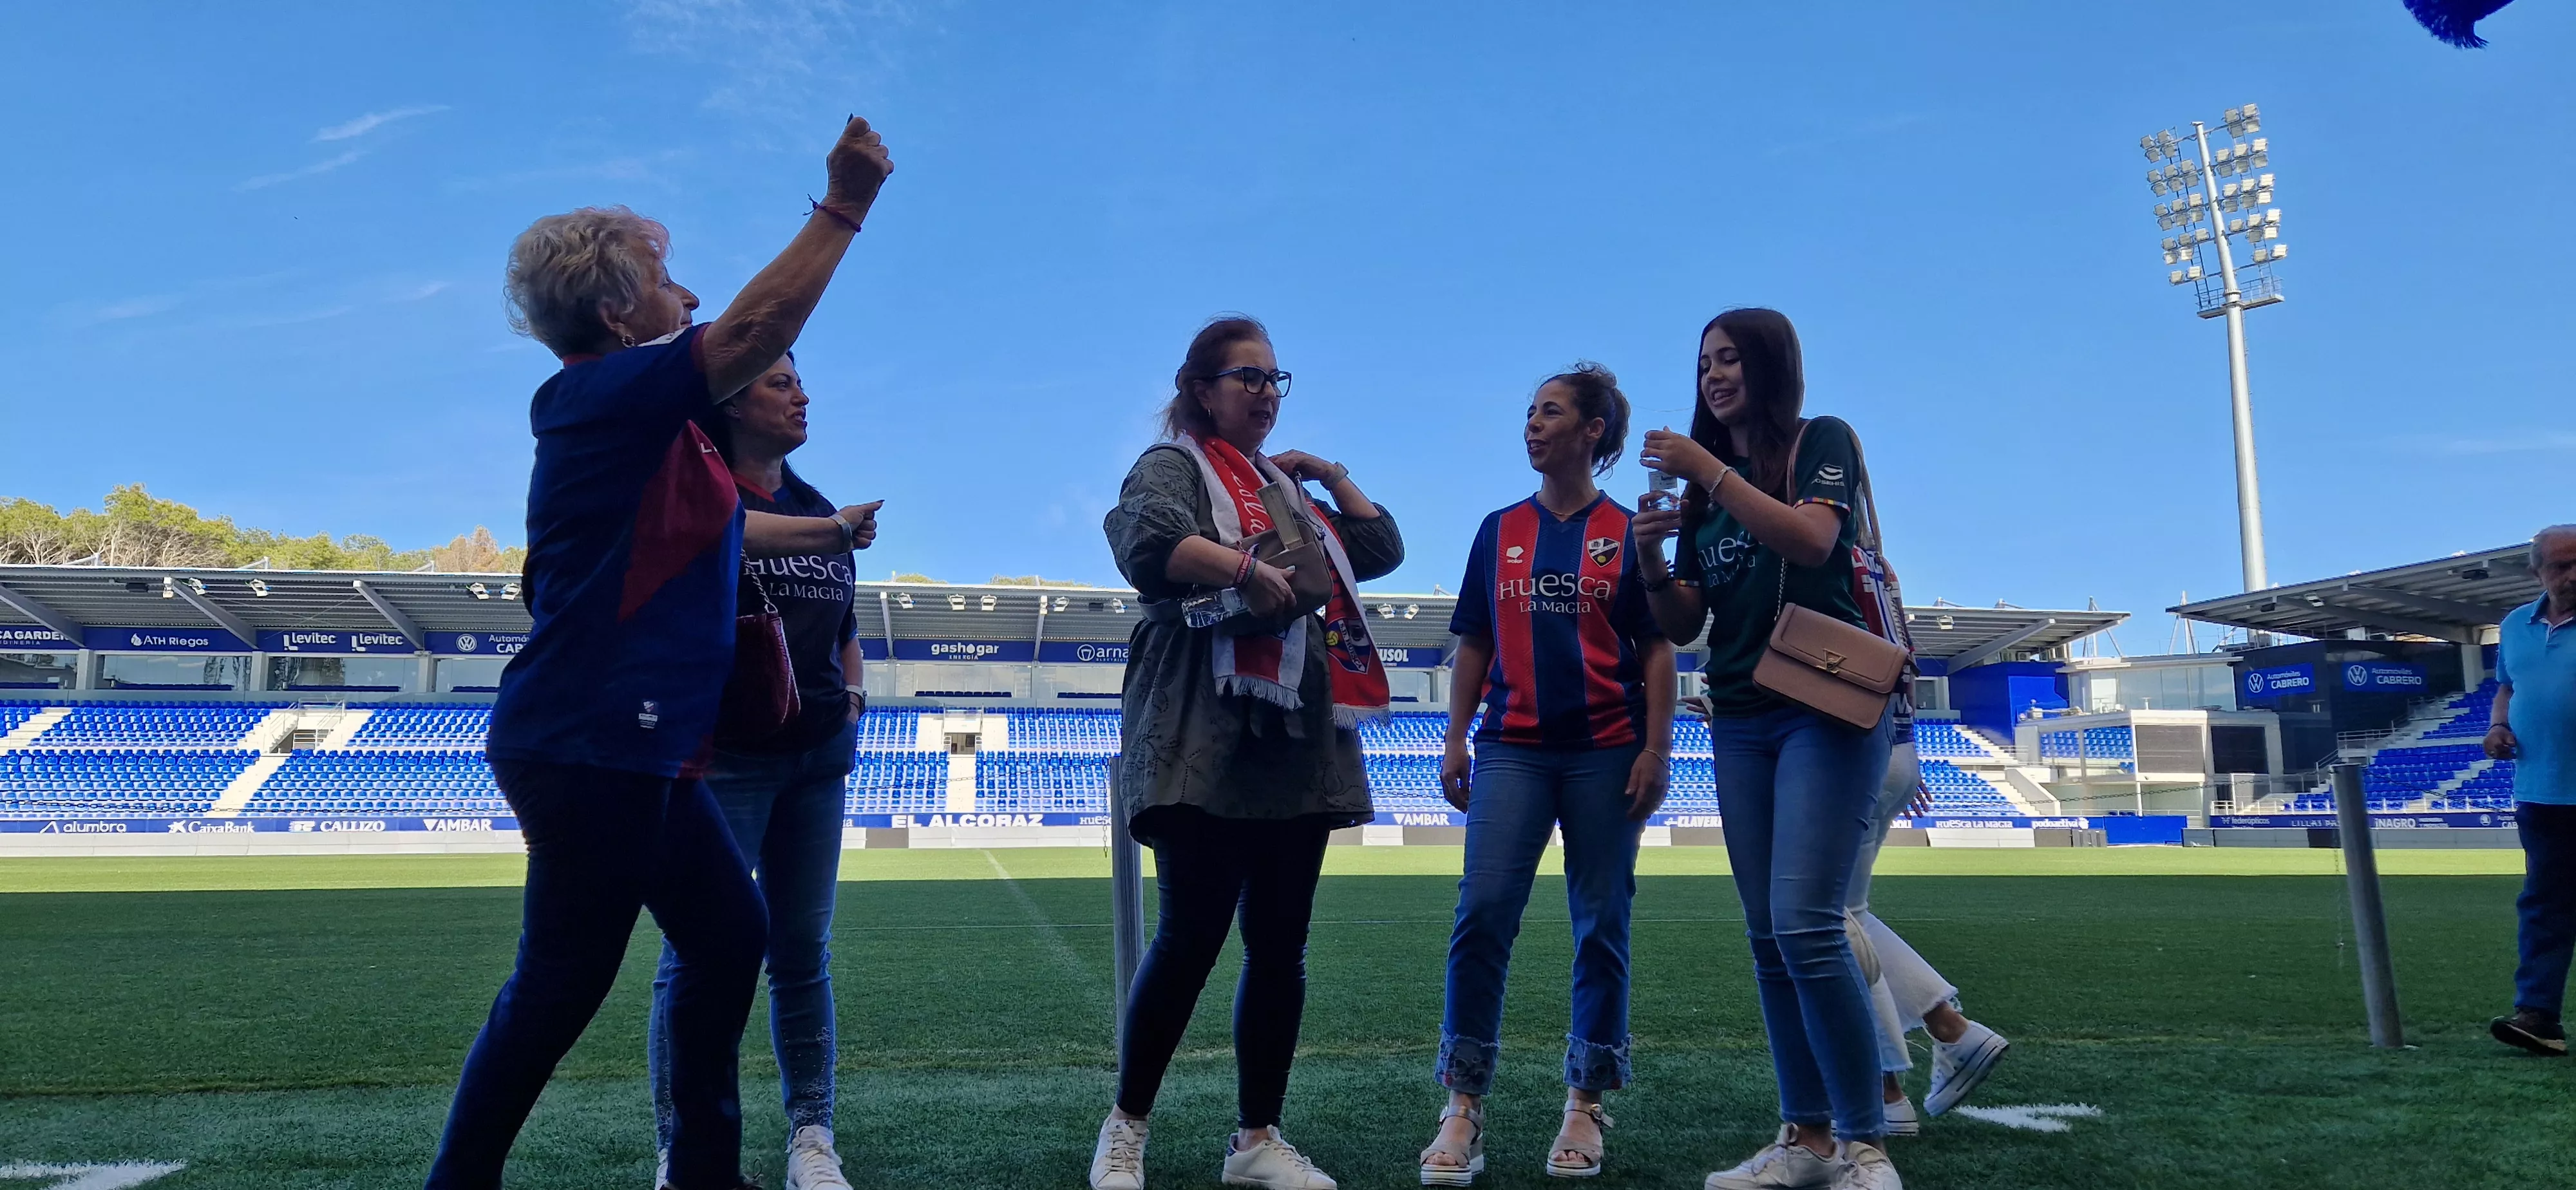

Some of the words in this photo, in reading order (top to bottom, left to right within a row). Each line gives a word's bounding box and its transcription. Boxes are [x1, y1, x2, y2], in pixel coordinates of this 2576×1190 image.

[169, 636, 209, 647] Riegos
[292, 632, 336, 645] Levitec
[359, 632, 404, 645] Levitec
[2271, 677, 2309, 689] CABRERO
[2376, 675, 2421, 685] CABRERO
[436, 819, 492, 831] AMBAR
[891, 815, 922, 828] EL
[929, 814, 1043, 827] ALCORAZ
[1404, 813, 1450, 825] AMBAR
[63, 821, 127, 833] alumbra
[187, 821, 254, 833] CaixaBank
[320, 820, 385, 831] CALLIZO
